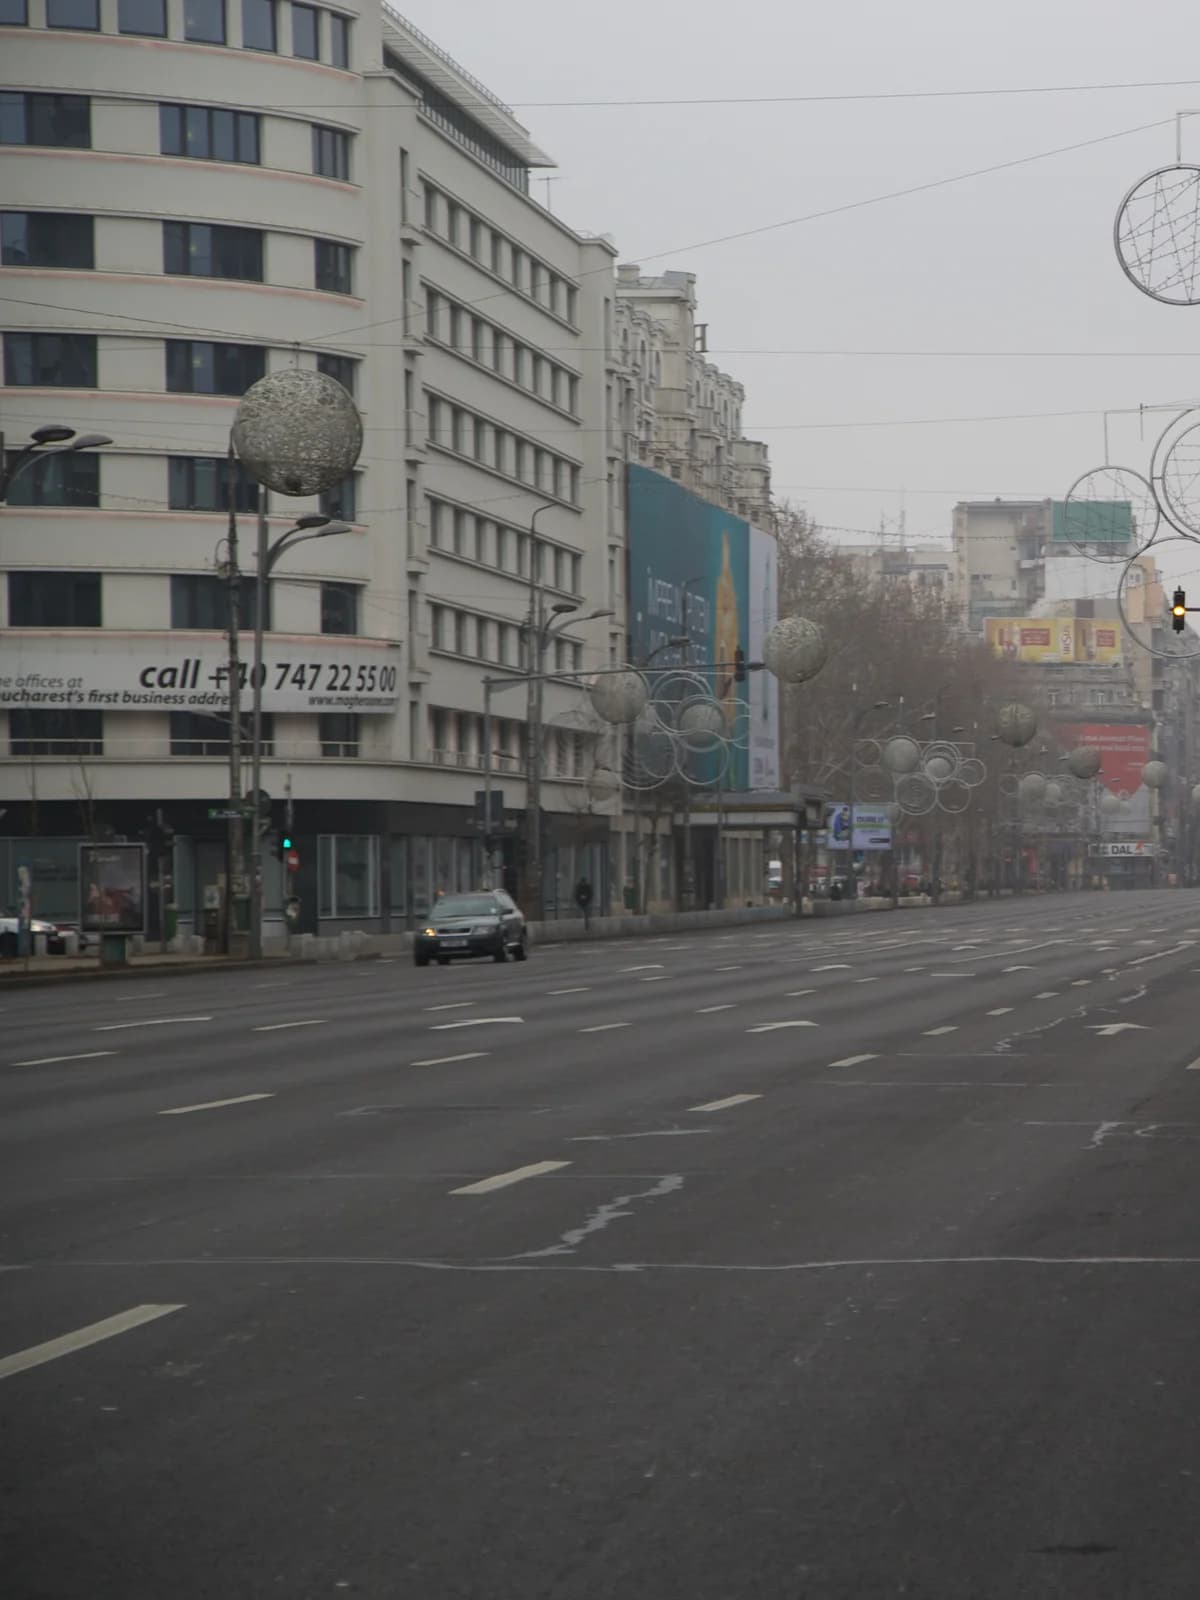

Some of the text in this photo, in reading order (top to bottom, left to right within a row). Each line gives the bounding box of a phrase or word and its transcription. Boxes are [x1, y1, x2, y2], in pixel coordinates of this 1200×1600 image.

[15, 673, 64, 688] offices
[67, 677, 83, 688] at
[140, 658, 200, 689] call
[274, 663, 322, 690] 747
[326, 663, 352, 691] 22
[356, 664, 377, 691] 55
[380, 665, 396, 692] 00
[0, 688, 233, 705] ucharest's first business addre
